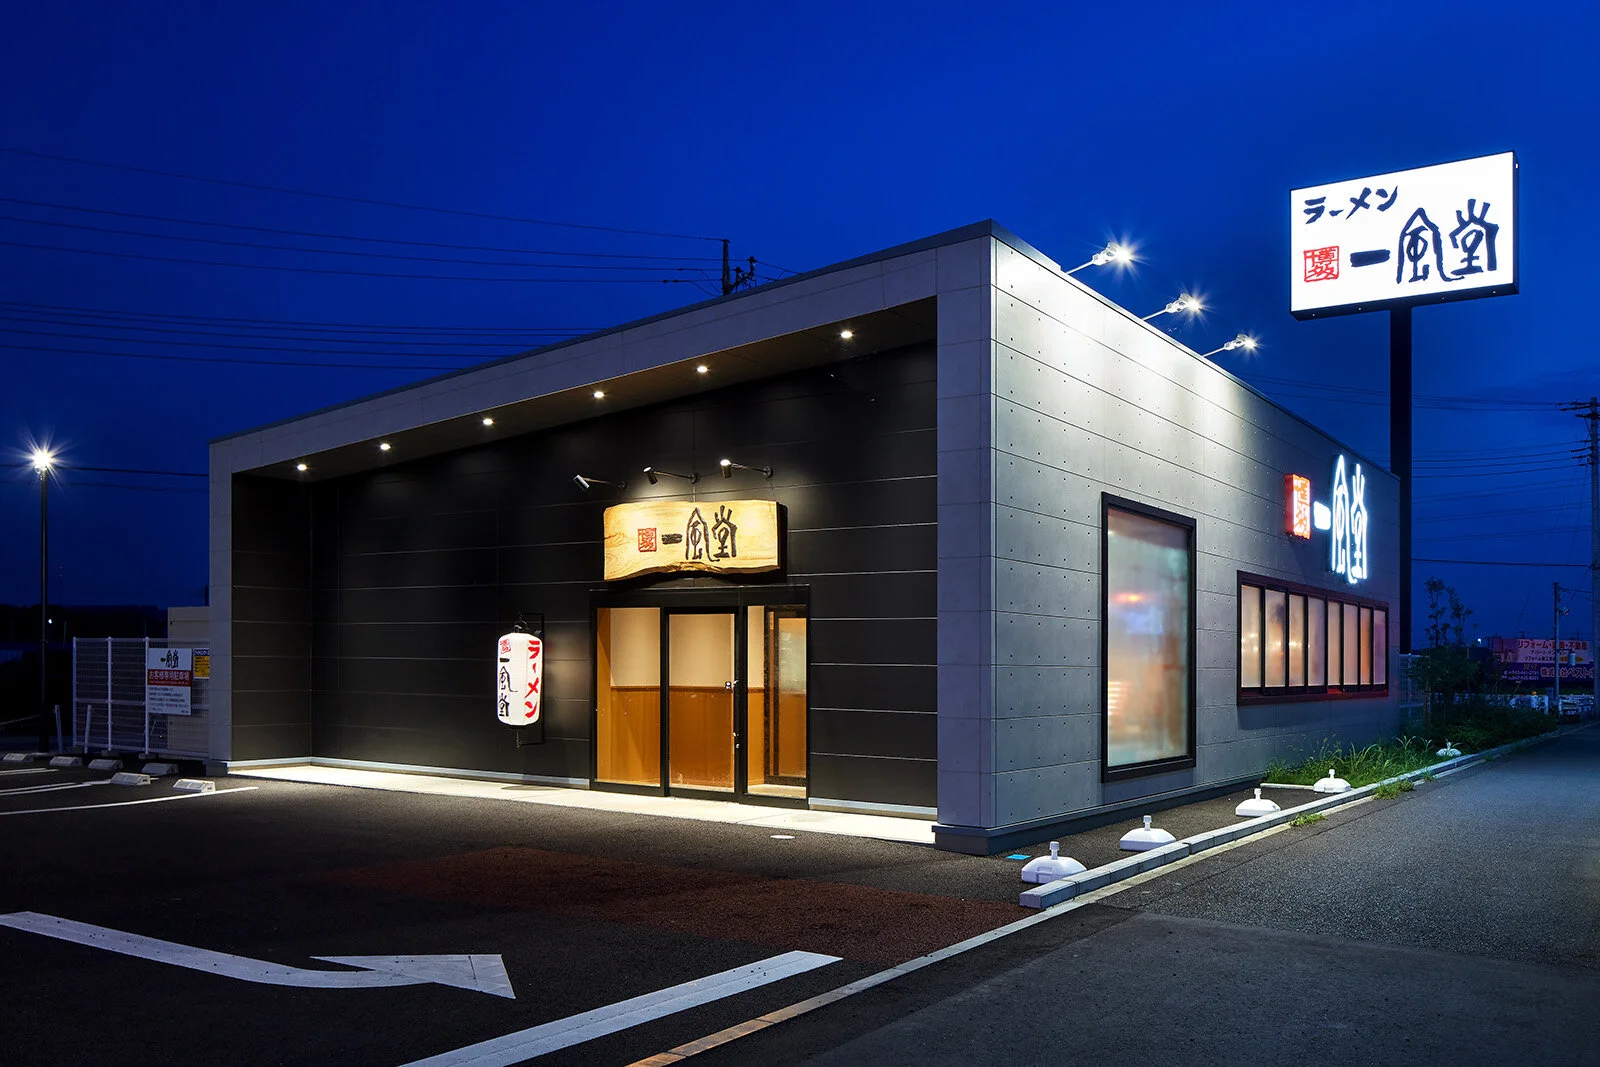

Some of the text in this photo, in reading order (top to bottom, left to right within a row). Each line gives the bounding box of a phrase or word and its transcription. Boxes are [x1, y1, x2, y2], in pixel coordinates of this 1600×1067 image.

[1303, 185, 1398, 225] ラーメン
[1303, 198, 1500, 284] 博多 一風堂
[661, 505, 738, 562] 一風堂
[1313, 454, 1368, 584] 一風堂
[499, 657, 518, 717] 一風堂
[524, 639, 541, 718] ラーメン
